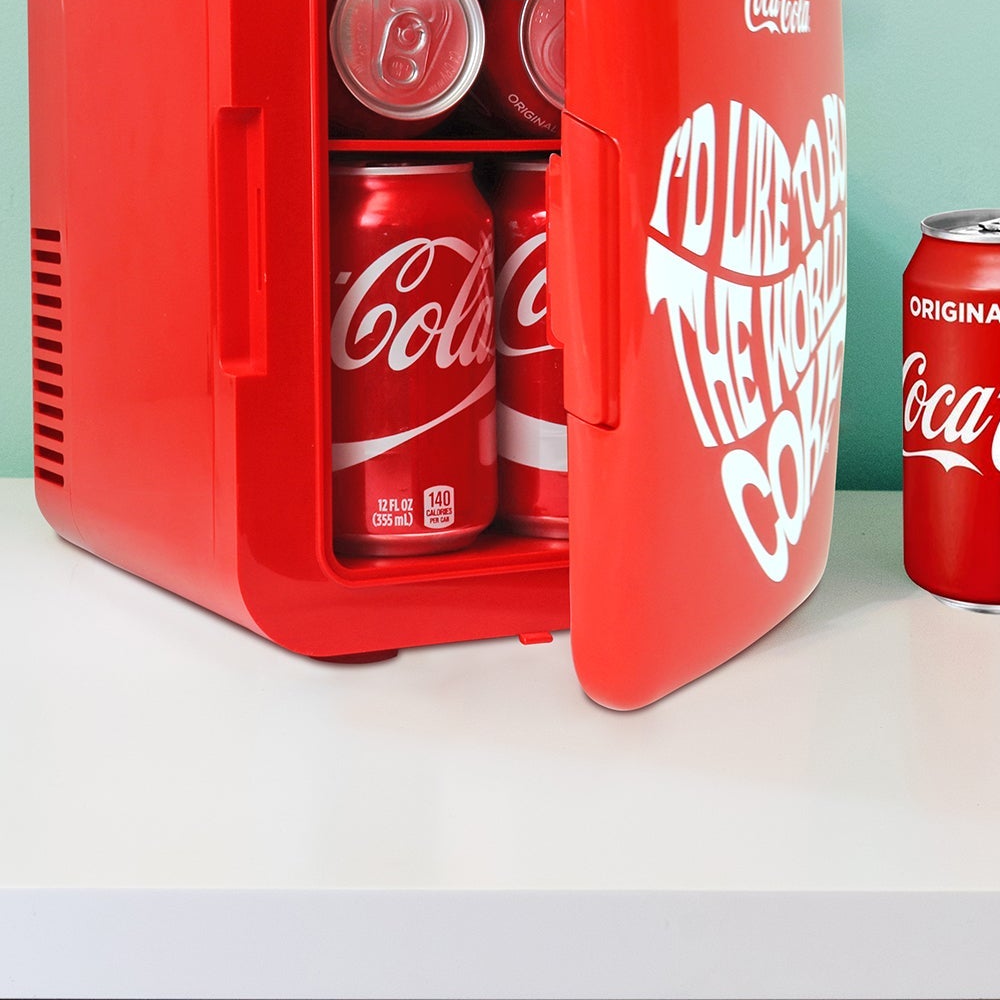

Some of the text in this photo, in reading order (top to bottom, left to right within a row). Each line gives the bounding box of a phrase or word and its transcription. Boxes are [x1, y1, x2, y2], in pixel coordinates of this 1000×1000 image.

[508, 94, 557, 132] ORIGINAL
[649, 103, 716, 256] I'D
[720, 100, 792, 276] LIKE
[792, 119, 826, 253] TO
[645, 235, 767, 447] THE
[760, 211, 844, 412] WORLD
[721, 301, 846, 582] COKE
[378, 498, 413, 512] 12 FL OZ
[426, 507, 453, 517] CALORIES
[429, 490, 450, 508] 140
[372, 512, 413, 528] (355 mL)
